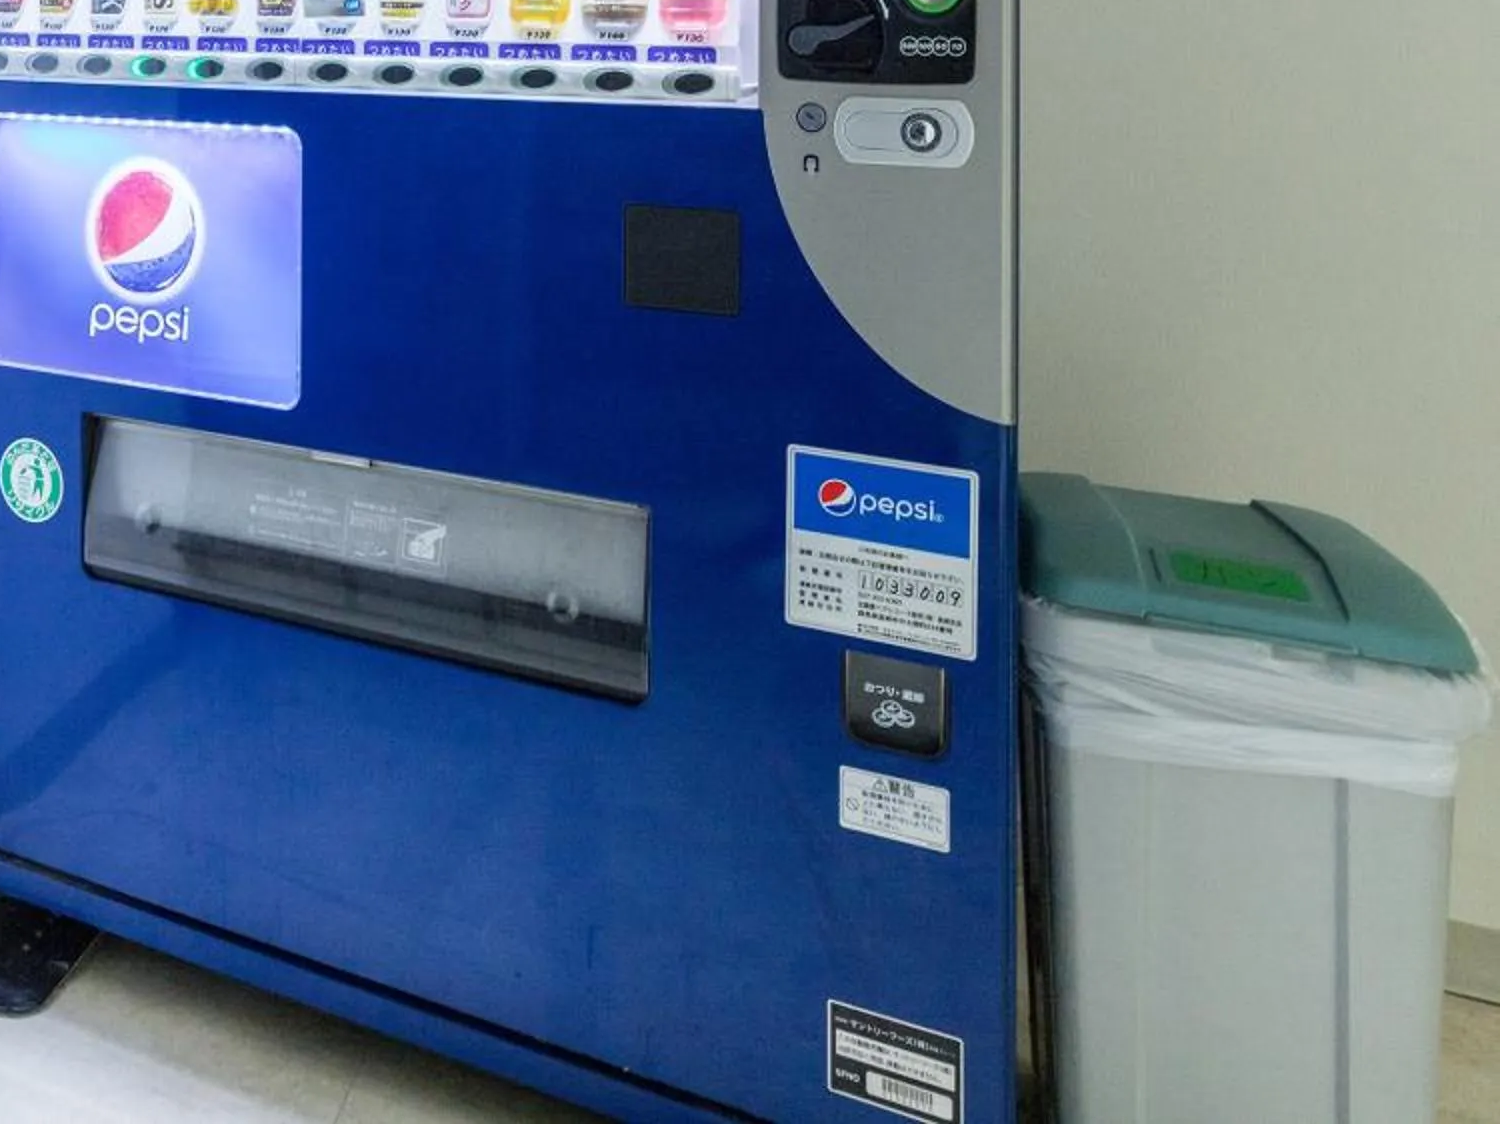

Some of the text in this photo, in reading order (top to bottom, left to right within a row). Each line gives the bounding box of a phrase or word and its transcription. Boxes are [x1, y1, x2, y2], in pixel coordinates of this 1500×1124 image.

[89, 302, 189, 343] pepsi
[859, 494, 934, 522] pepsi
[860, 576, 961, 604] 1033009
